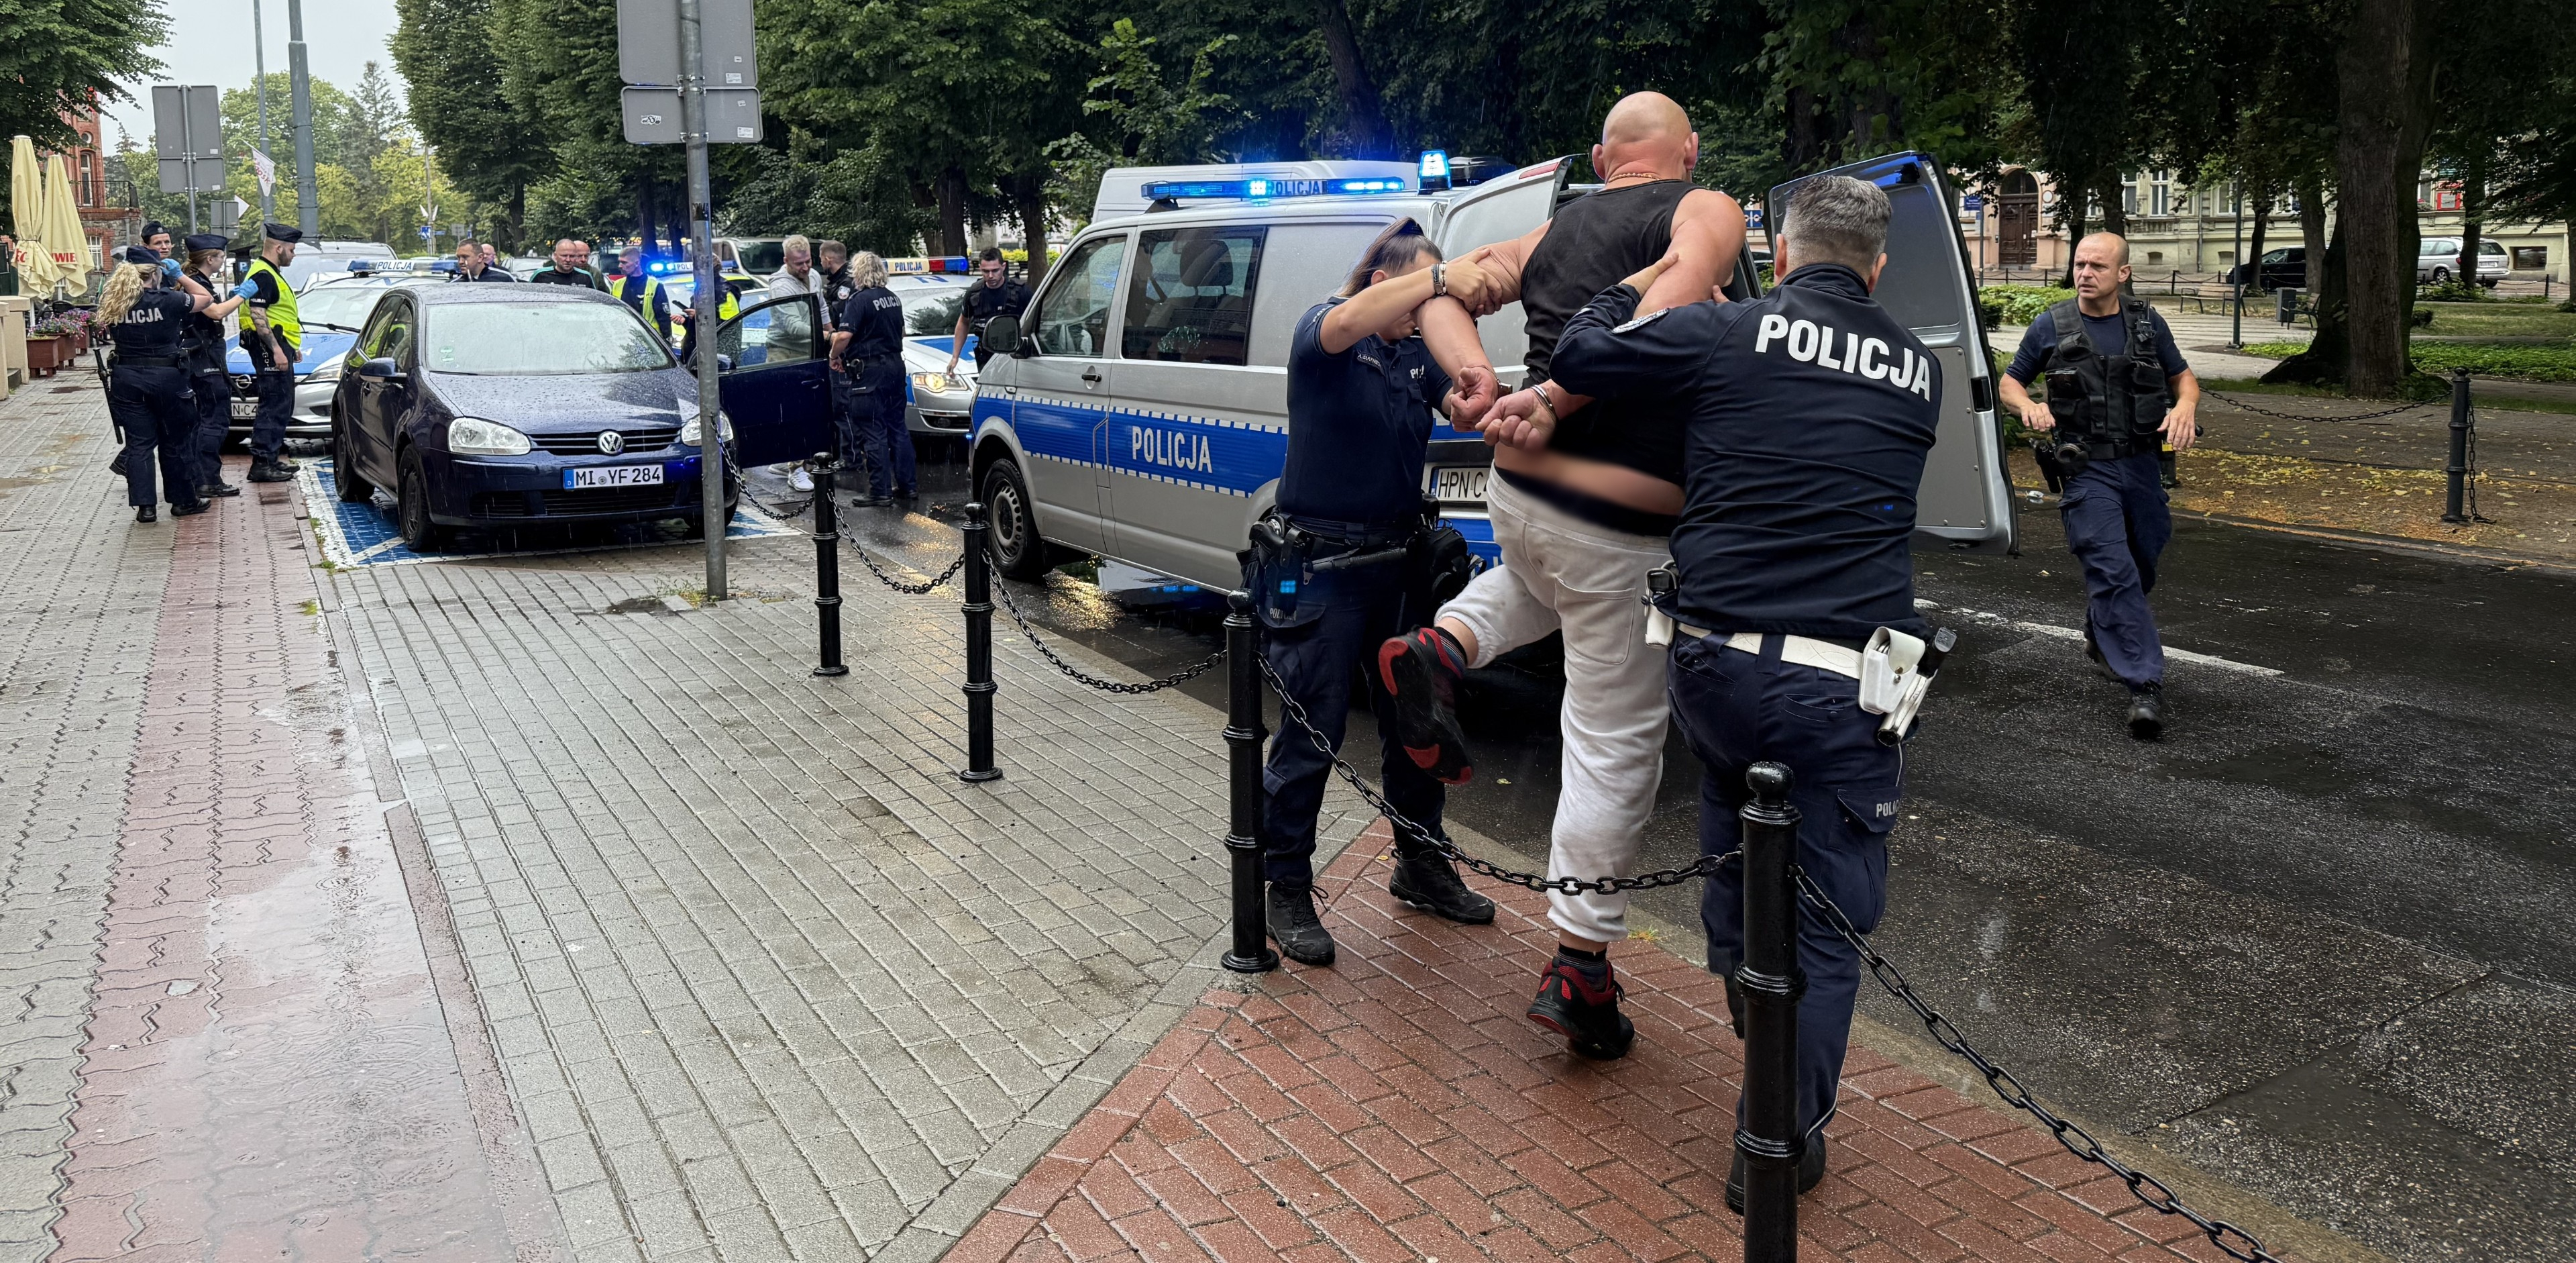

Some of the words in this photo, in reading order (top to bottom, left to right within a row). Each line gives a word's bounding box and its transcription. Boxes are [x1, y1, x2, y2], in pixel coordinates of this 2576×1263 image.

[1267, 181, 1320, 195] POLICJA
[52, 252, 76, 262] WIE
[377, 261, 412, 270] POLICJA
[895, 262, 922, 271] POLICJA
[1755, 314, 1930, 402] POLICJA
[1132, 425, 1213, 474] POLICJA
[576, 470, 596, 486] MI
[608, 469, 629, 484] YF
[632, 467, 661, 483] 284
[1438, 471, 1470, 498] HPN
[1876, 799, 1901, 817] POLIC
